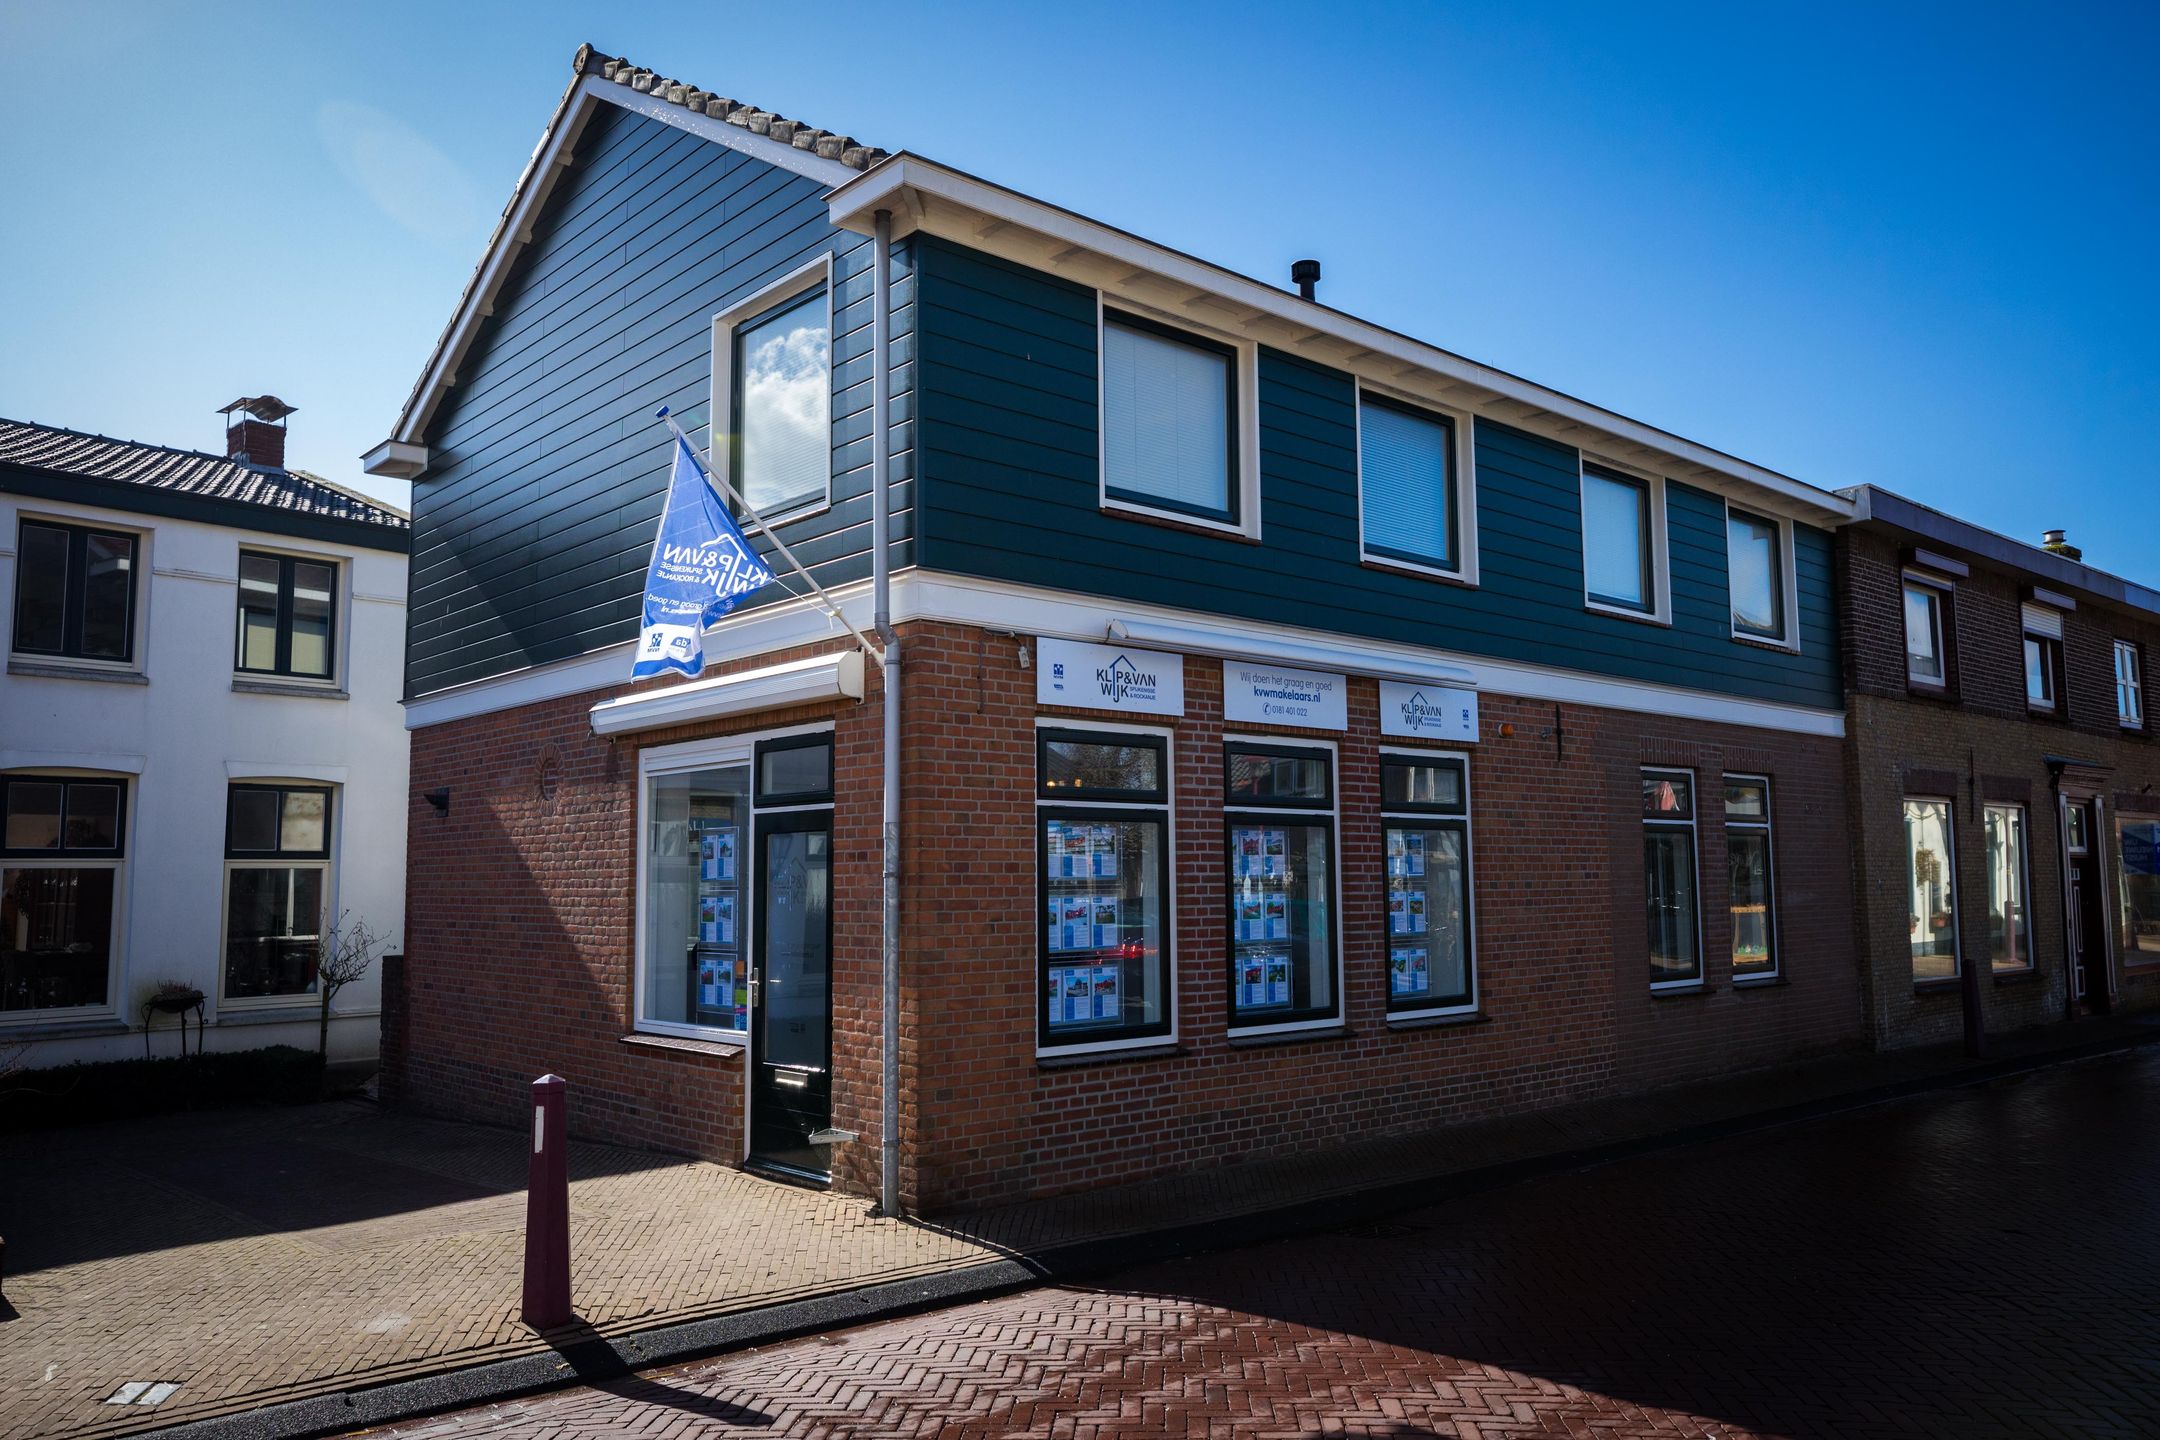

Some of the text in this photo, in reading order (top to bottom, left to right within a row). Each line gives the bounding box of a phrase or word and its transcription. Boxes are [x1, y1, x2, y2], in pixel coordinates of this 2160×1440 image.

[1240, 671, 1332, 692] Wij doen het graag en goed
[1253, 685, 1321, 702] kvwmakelaars.nl
[1271, 705, 1308, 717] 0181 401 022
